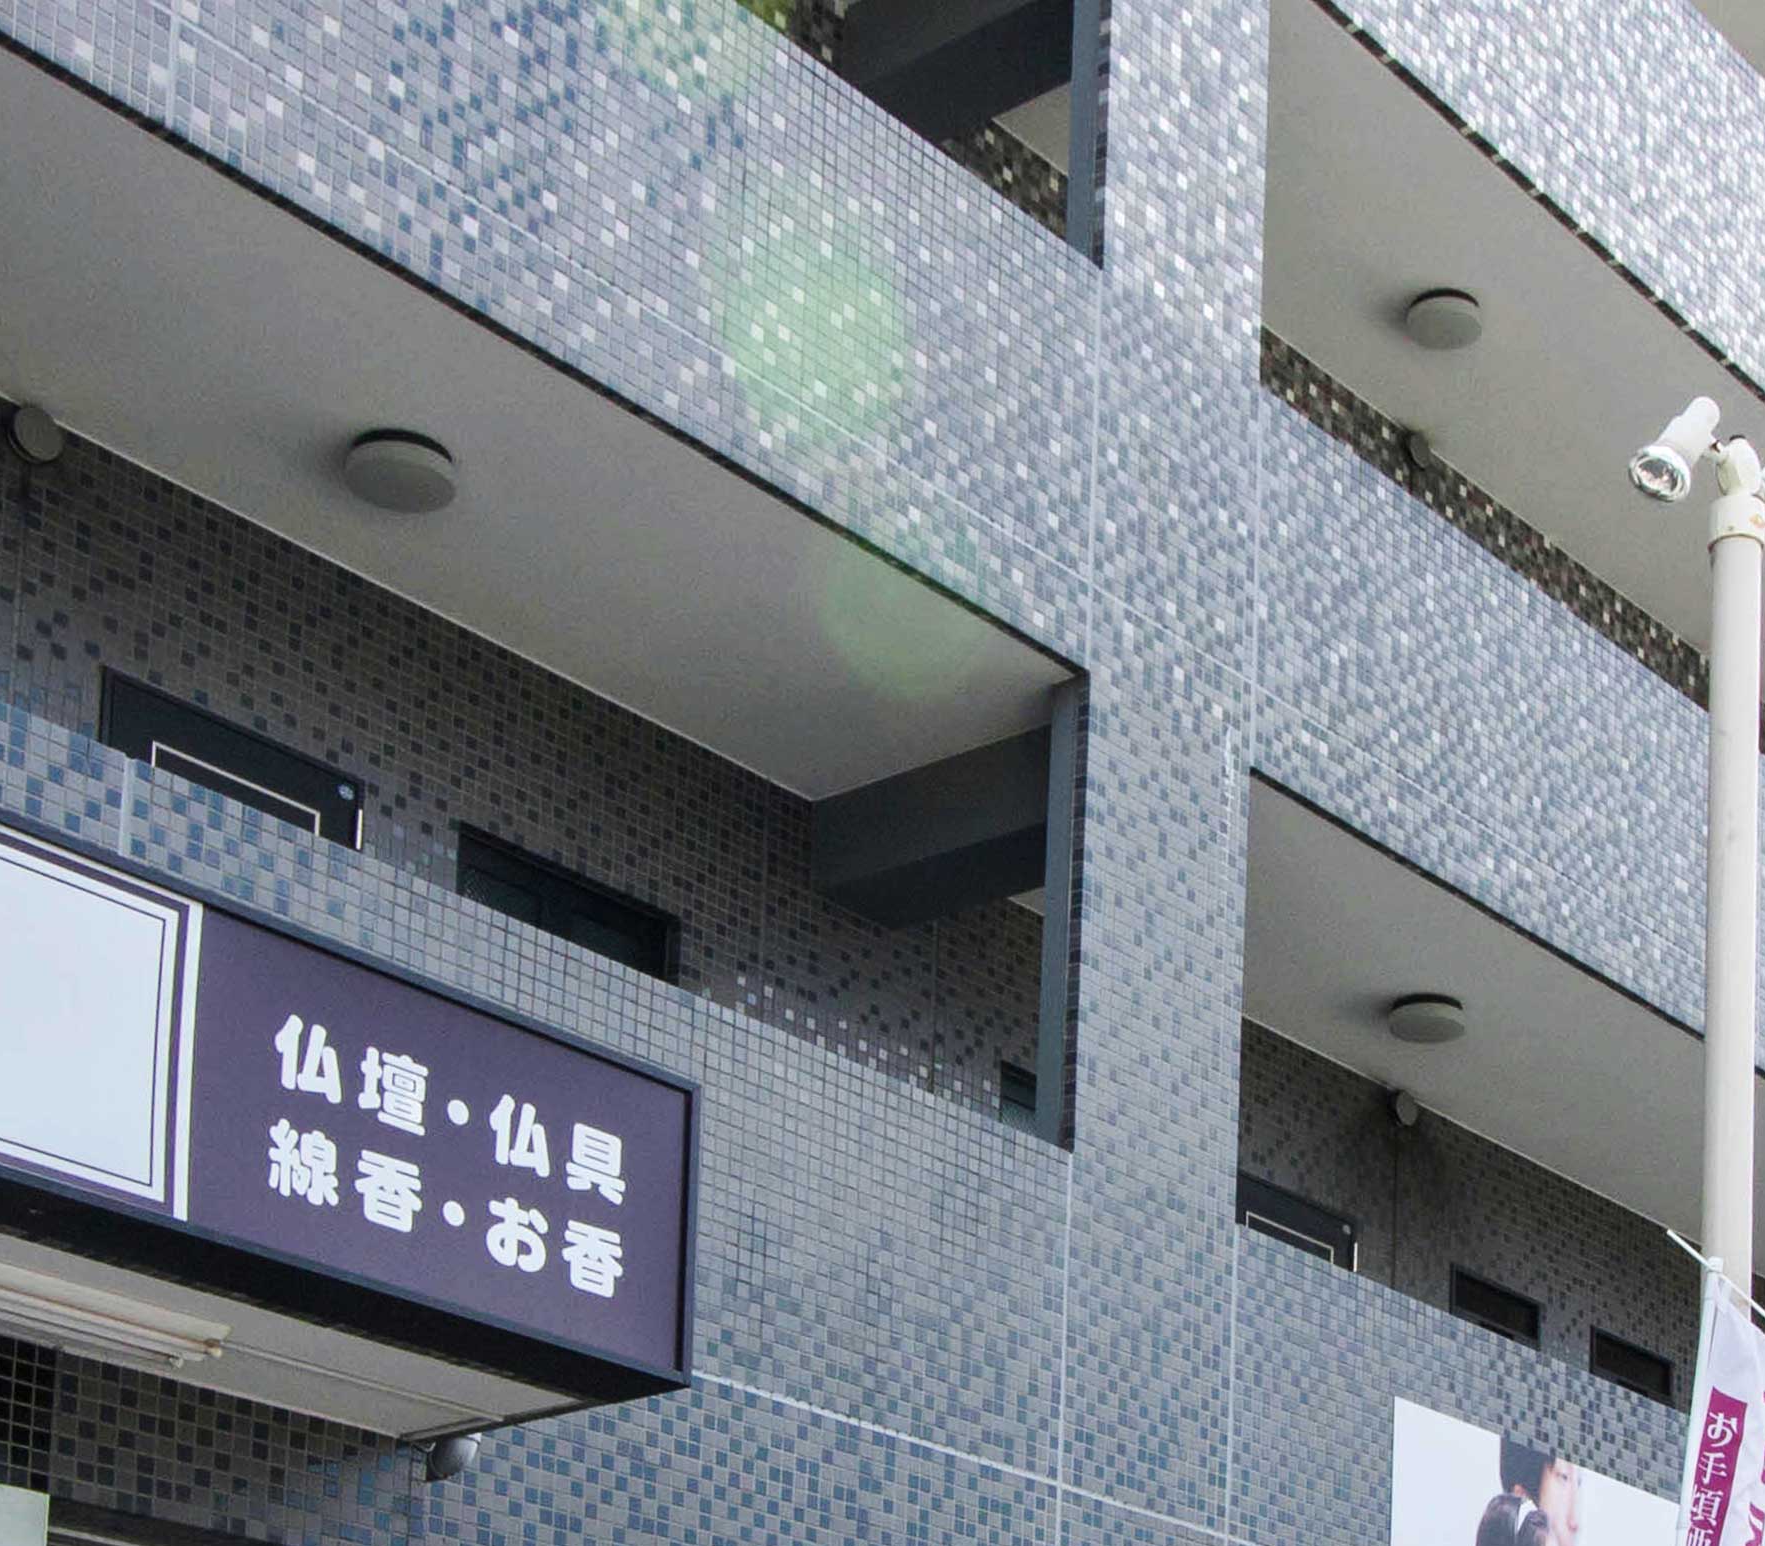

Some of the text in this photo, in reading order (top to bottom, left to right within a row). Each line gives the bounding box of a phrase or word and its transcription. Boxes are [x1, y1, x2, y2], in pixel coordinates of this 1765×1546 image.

[273, 1013, 627, 1206] 仏壇・仏具
[267, 1118, 625, 1299] 線香・お香
